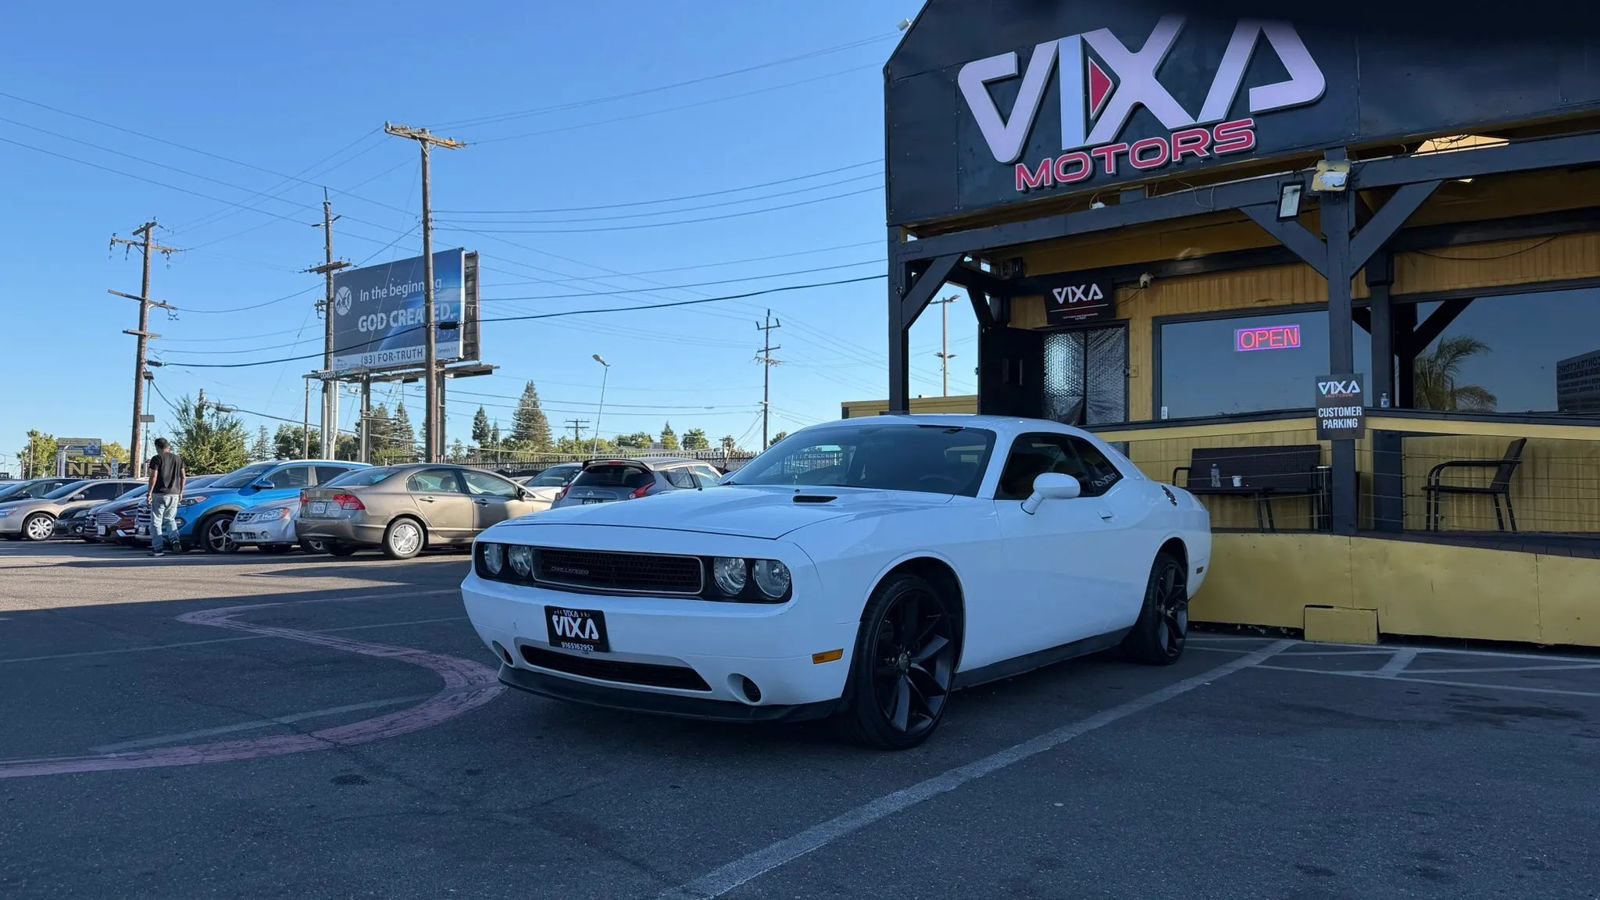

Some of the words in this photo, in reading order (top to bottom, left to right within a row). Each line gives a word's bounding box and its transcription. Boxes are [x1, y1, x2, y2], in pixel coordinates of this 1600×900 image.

[958, 18, 1326, 164] VIXA
[1015, 117, 1256, 192] MOTORS
[360, 289, 369, 302] In
[372, 285, 387, 299] the
[389, 279, 442, 298] beginng
[1052, 283, 1104, 305] VIXA
[358, 313, 387, 332] GOD
[389, 303, 454, 328] CREAED.
[1240, 328, 1298, 349] OPEN
[377, 349, 423, 362] FOR-TRUTH
[1318, 380, 1361, 395] VIXA
[1318, 406, 1362, 418] CUSTOMER
[1322, 418, 1358, 429] PARKING
[552, 615, 599, 639] VIXA
